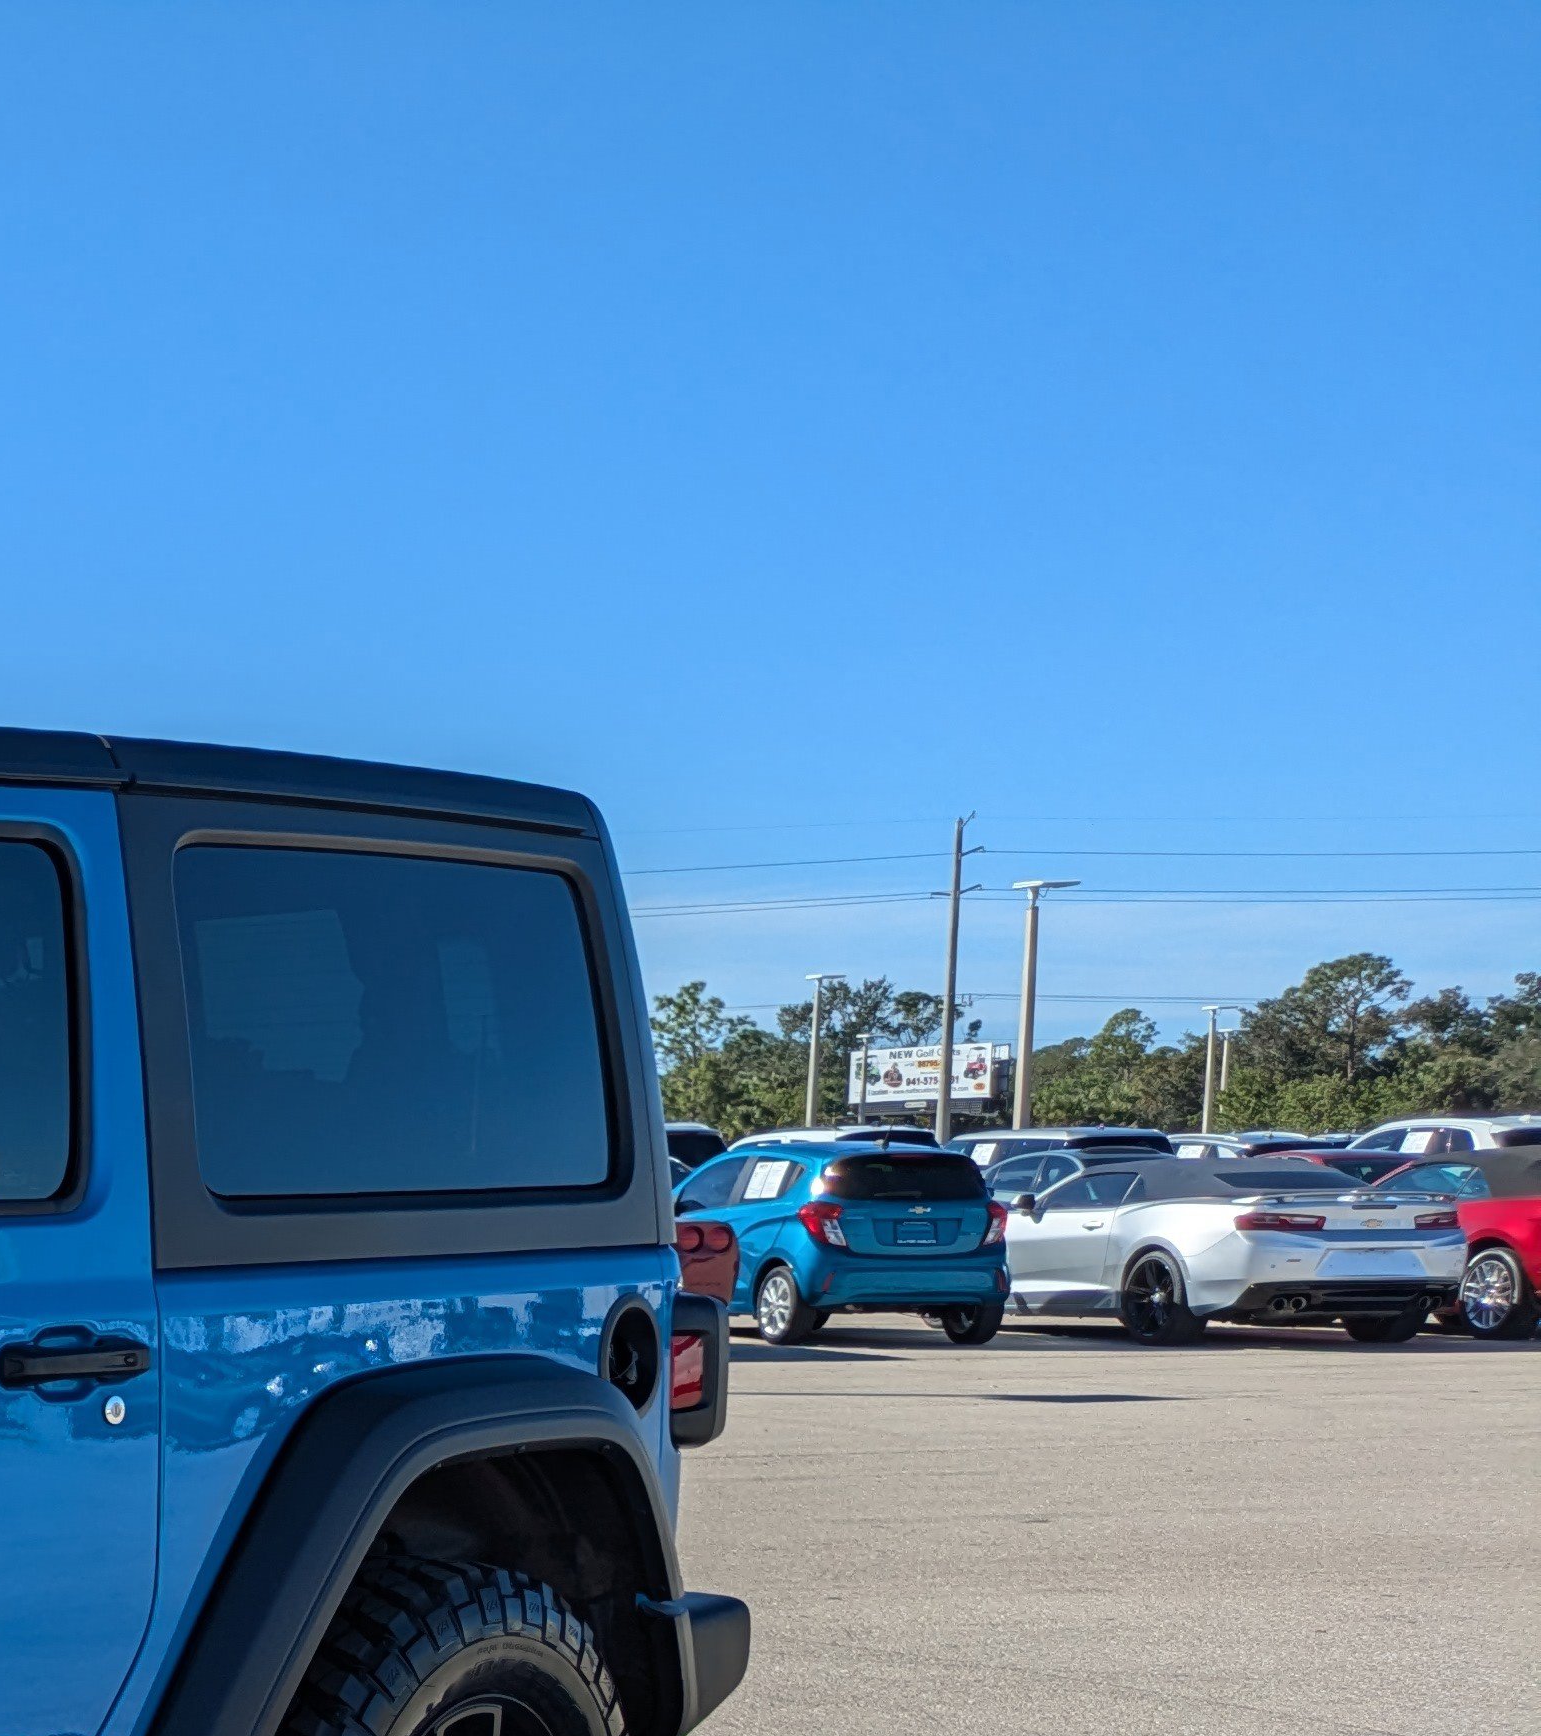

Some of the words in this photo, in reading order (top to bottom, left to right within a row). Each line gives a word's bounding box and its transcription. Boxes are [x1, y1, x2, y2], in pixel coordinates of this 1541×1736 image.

[889, 1050, 913, 1059] NEW
[916, 1048, 934, 1058] Golf
[937, 1048, 961, 1056] Cts
